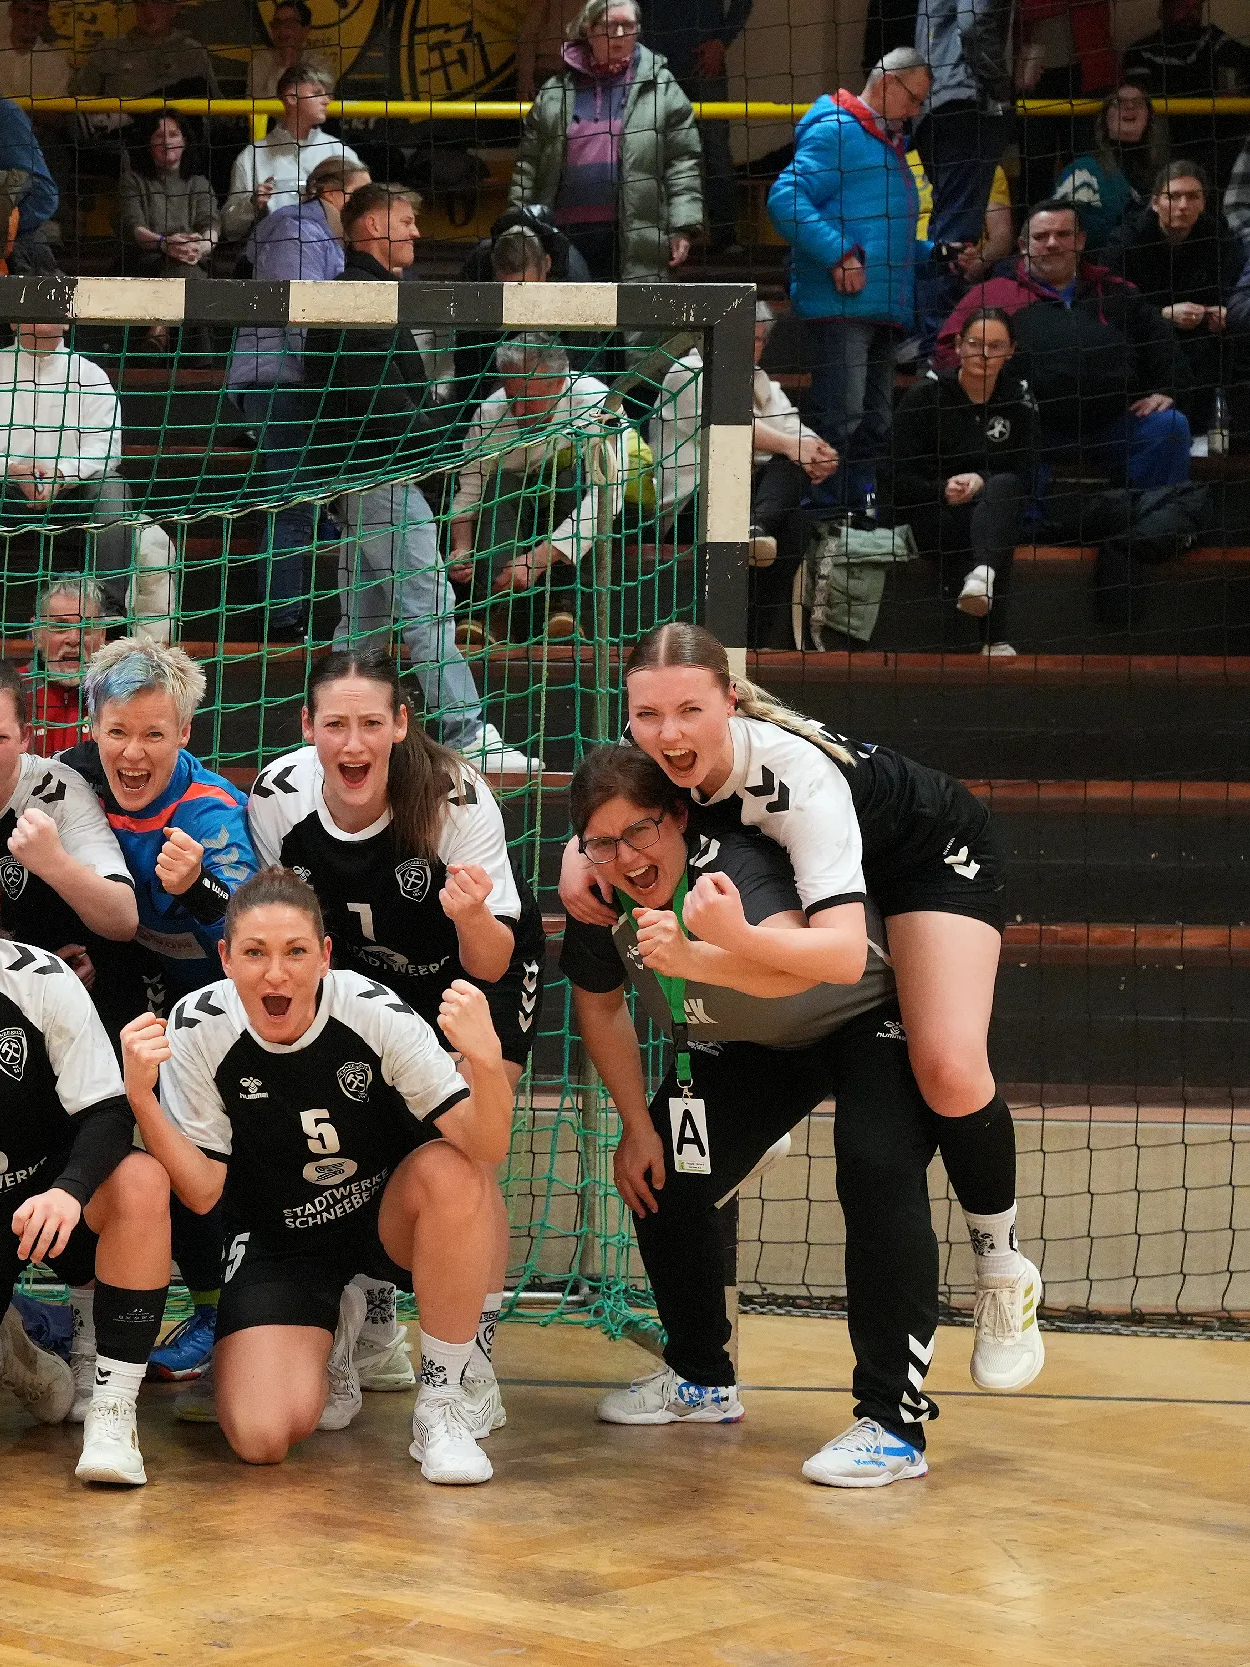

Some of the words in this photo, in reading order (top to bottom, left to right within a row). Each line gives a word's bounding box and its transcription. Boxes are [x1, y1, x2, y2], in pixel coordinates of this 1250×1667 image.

[239, 1091, 269, 1100] hummel
[299, 1108, 341, 1155] 5
[676, 1108, 707, 1157] A
[282, 1167, 389, 1217] STADTWERKE
